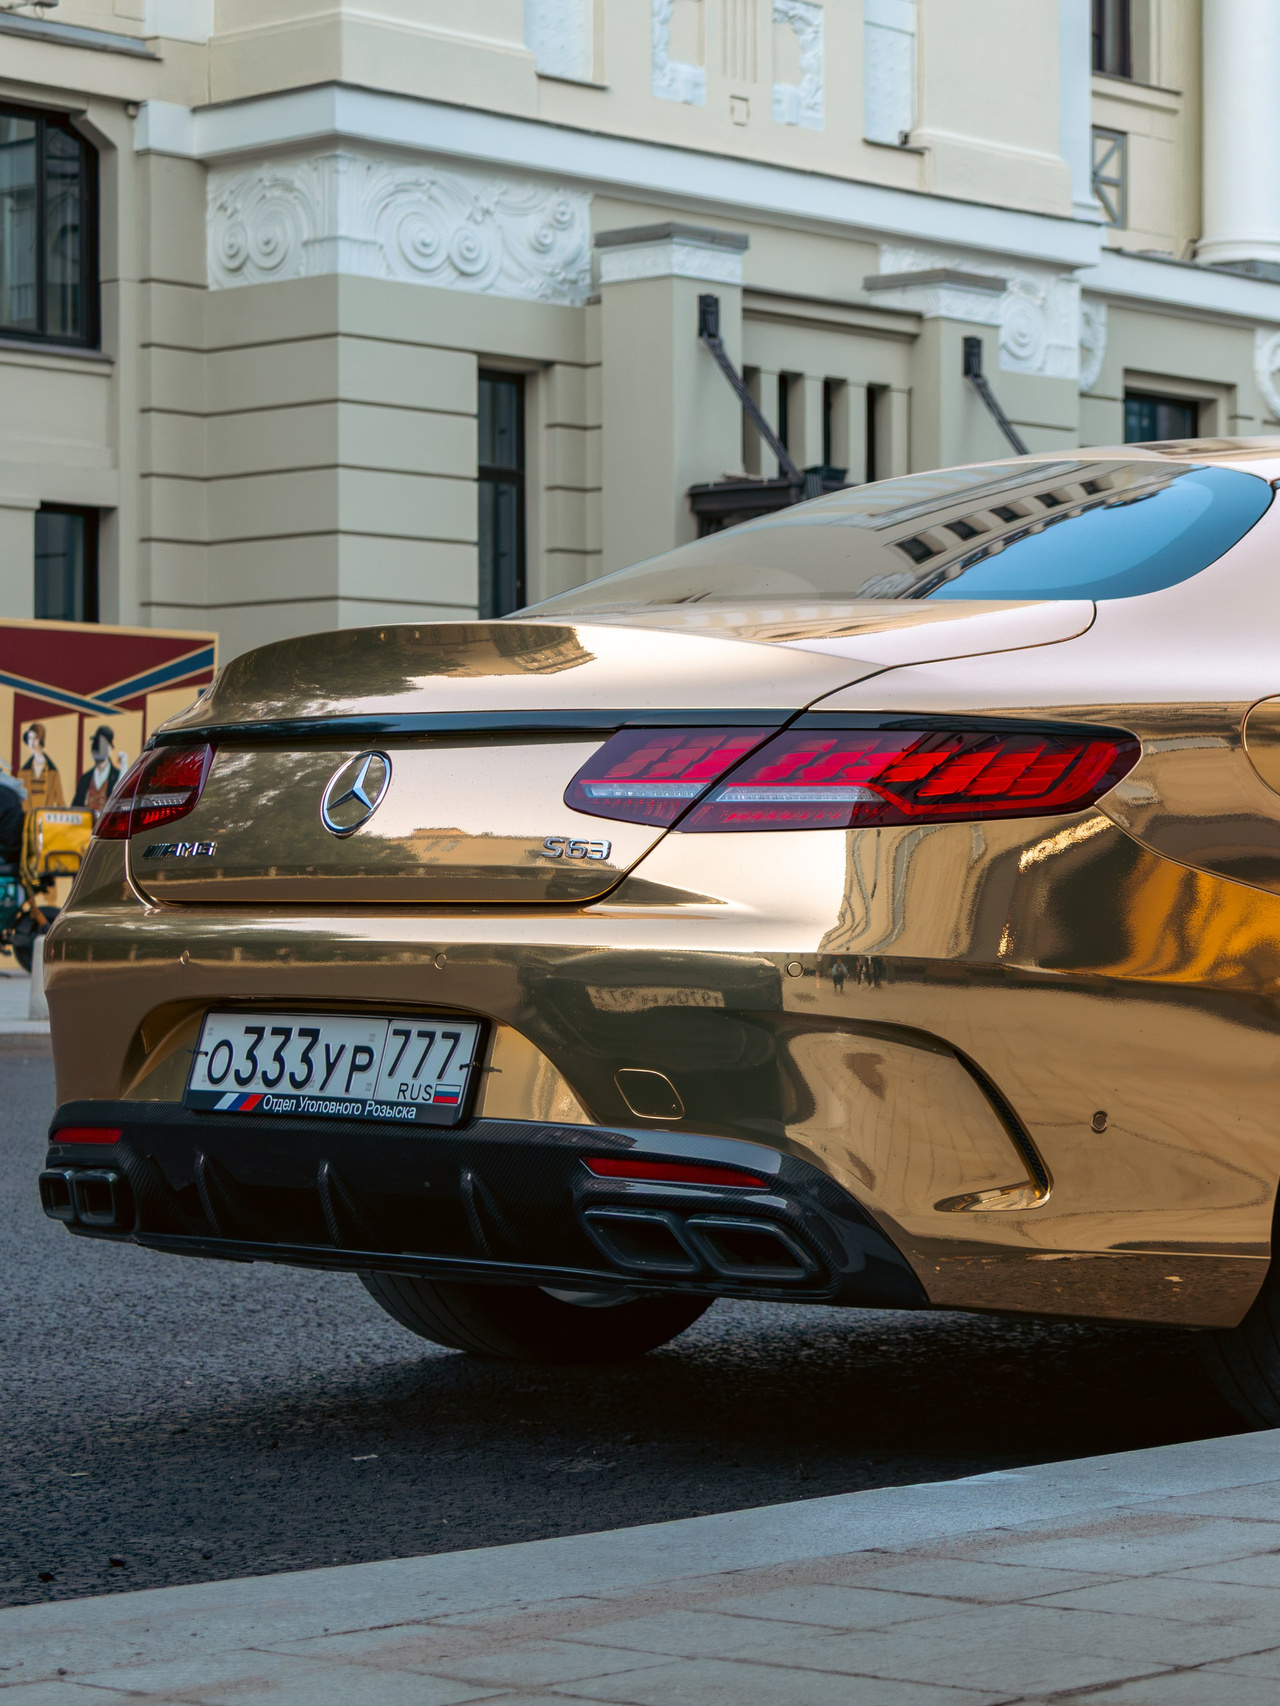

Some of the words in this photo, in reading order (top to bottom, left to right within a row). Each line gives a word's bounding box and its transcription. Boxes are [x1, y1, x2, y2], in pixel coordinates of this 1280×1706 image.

[163, 842, 217, 858] AMG
[540, 837, 612, 861] S63
[206, 1026, 375, 1093] О333УР
[387, 1029, 462, 1080] 777
[397, 1082, 433, 1102] RUS
[263, 1095, 296, 1113] Отдел
[298, 1096, 361, 1116] Уголовного
[364, 1100, 417, 1119] Розыска
